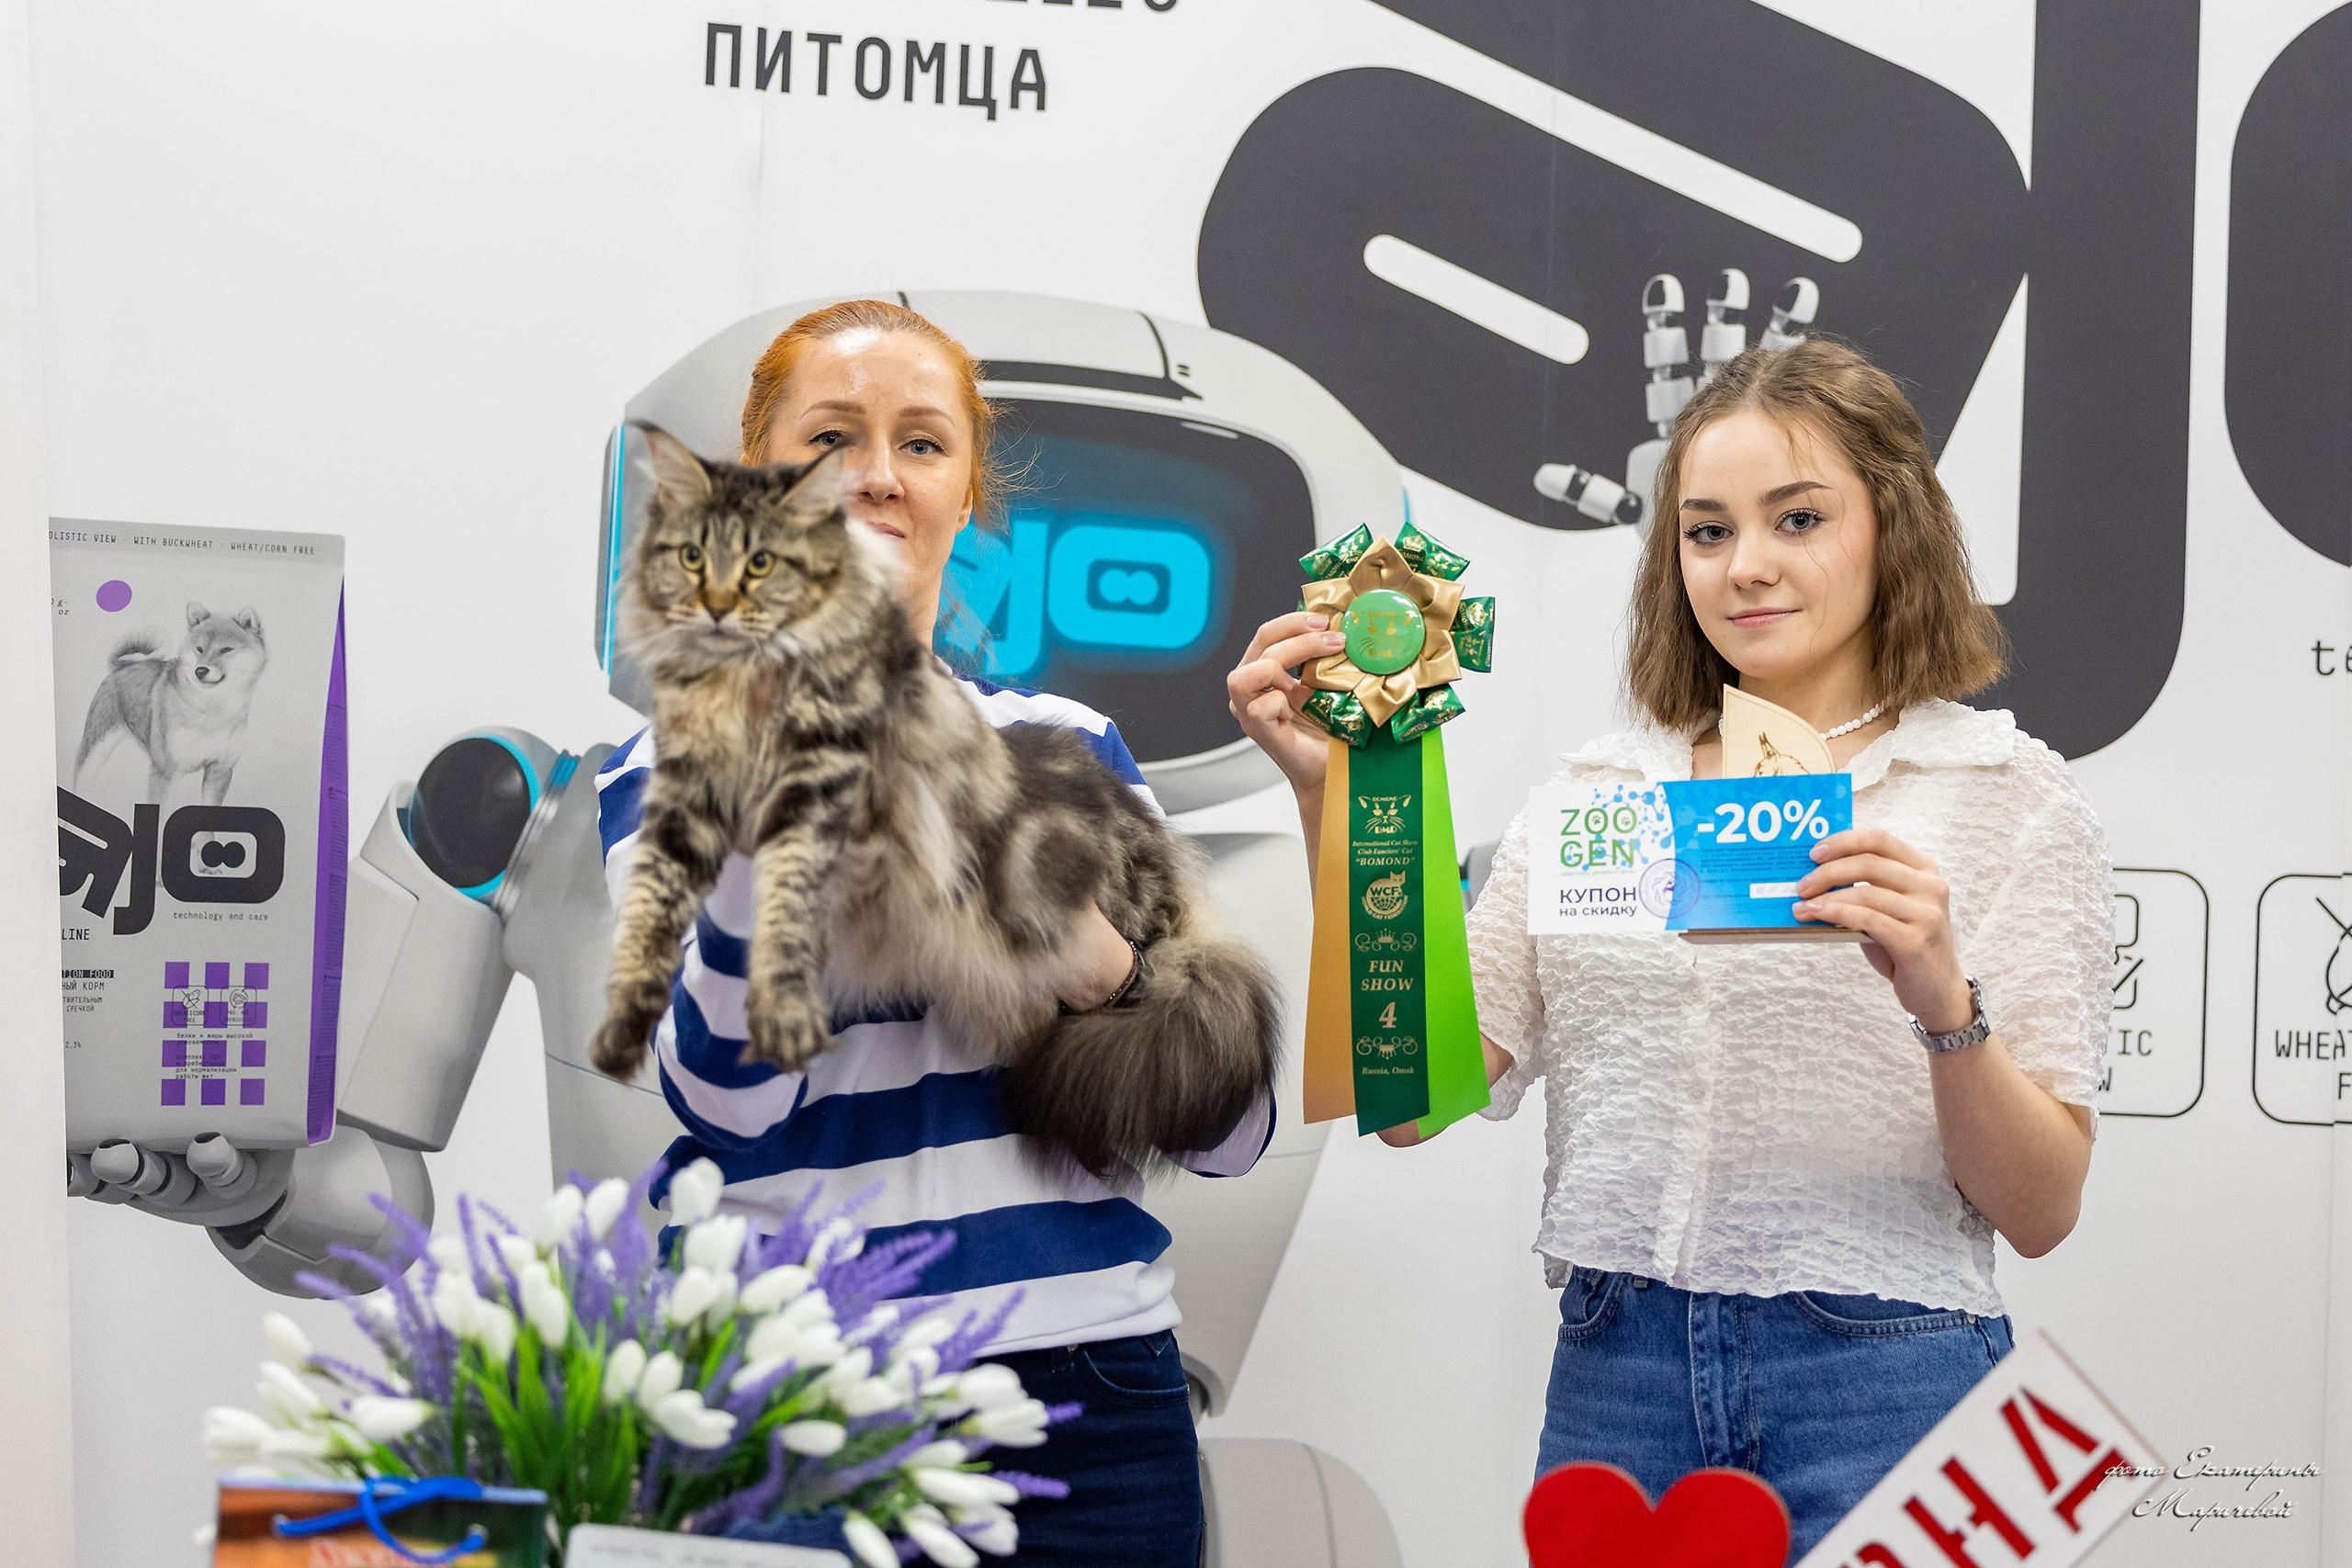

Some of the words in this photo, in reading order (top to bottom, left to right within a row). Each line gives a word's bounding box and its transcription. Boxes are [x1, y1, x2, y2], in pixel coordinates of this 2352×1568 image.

[706, 22, 1046, 121] ПИТОМЦА
[94, 534, 117, 544] VIEW
[133, 536, 157, 547] WITH
[162, 537, 214, 549] BUCKWHEAT
[231, 541, 288, 553] WHEAT/CORN
[293, 546, 316, 556] FREE
[1560, 807, 1637, 836] ZOO
[1697, 798, 1829, 844] -20%
[1560, 839, 1634, 867] GEN
[1369, 886, 1399, 897] WCF
[1560, 886, 1637, 904] КУПОН
[173, 911, 223, 920] technology
[229, 912, 243, 920] and
[1559, 908, 1577, 917] на
[1582, 906, 1637, 917] скидку
[62, 929, 90, 941] LINE
[1369, 960, 1404, 973] FUN
[83, 981, 105, 991] КОРМ
[1361, 978, 1414, 991] SHOW
[1378, 1001, 1397, 1029] 4
[1362, 1066, 1390, 1076] Russia,
[1392, 1066, 1416, 1075] Omsk
